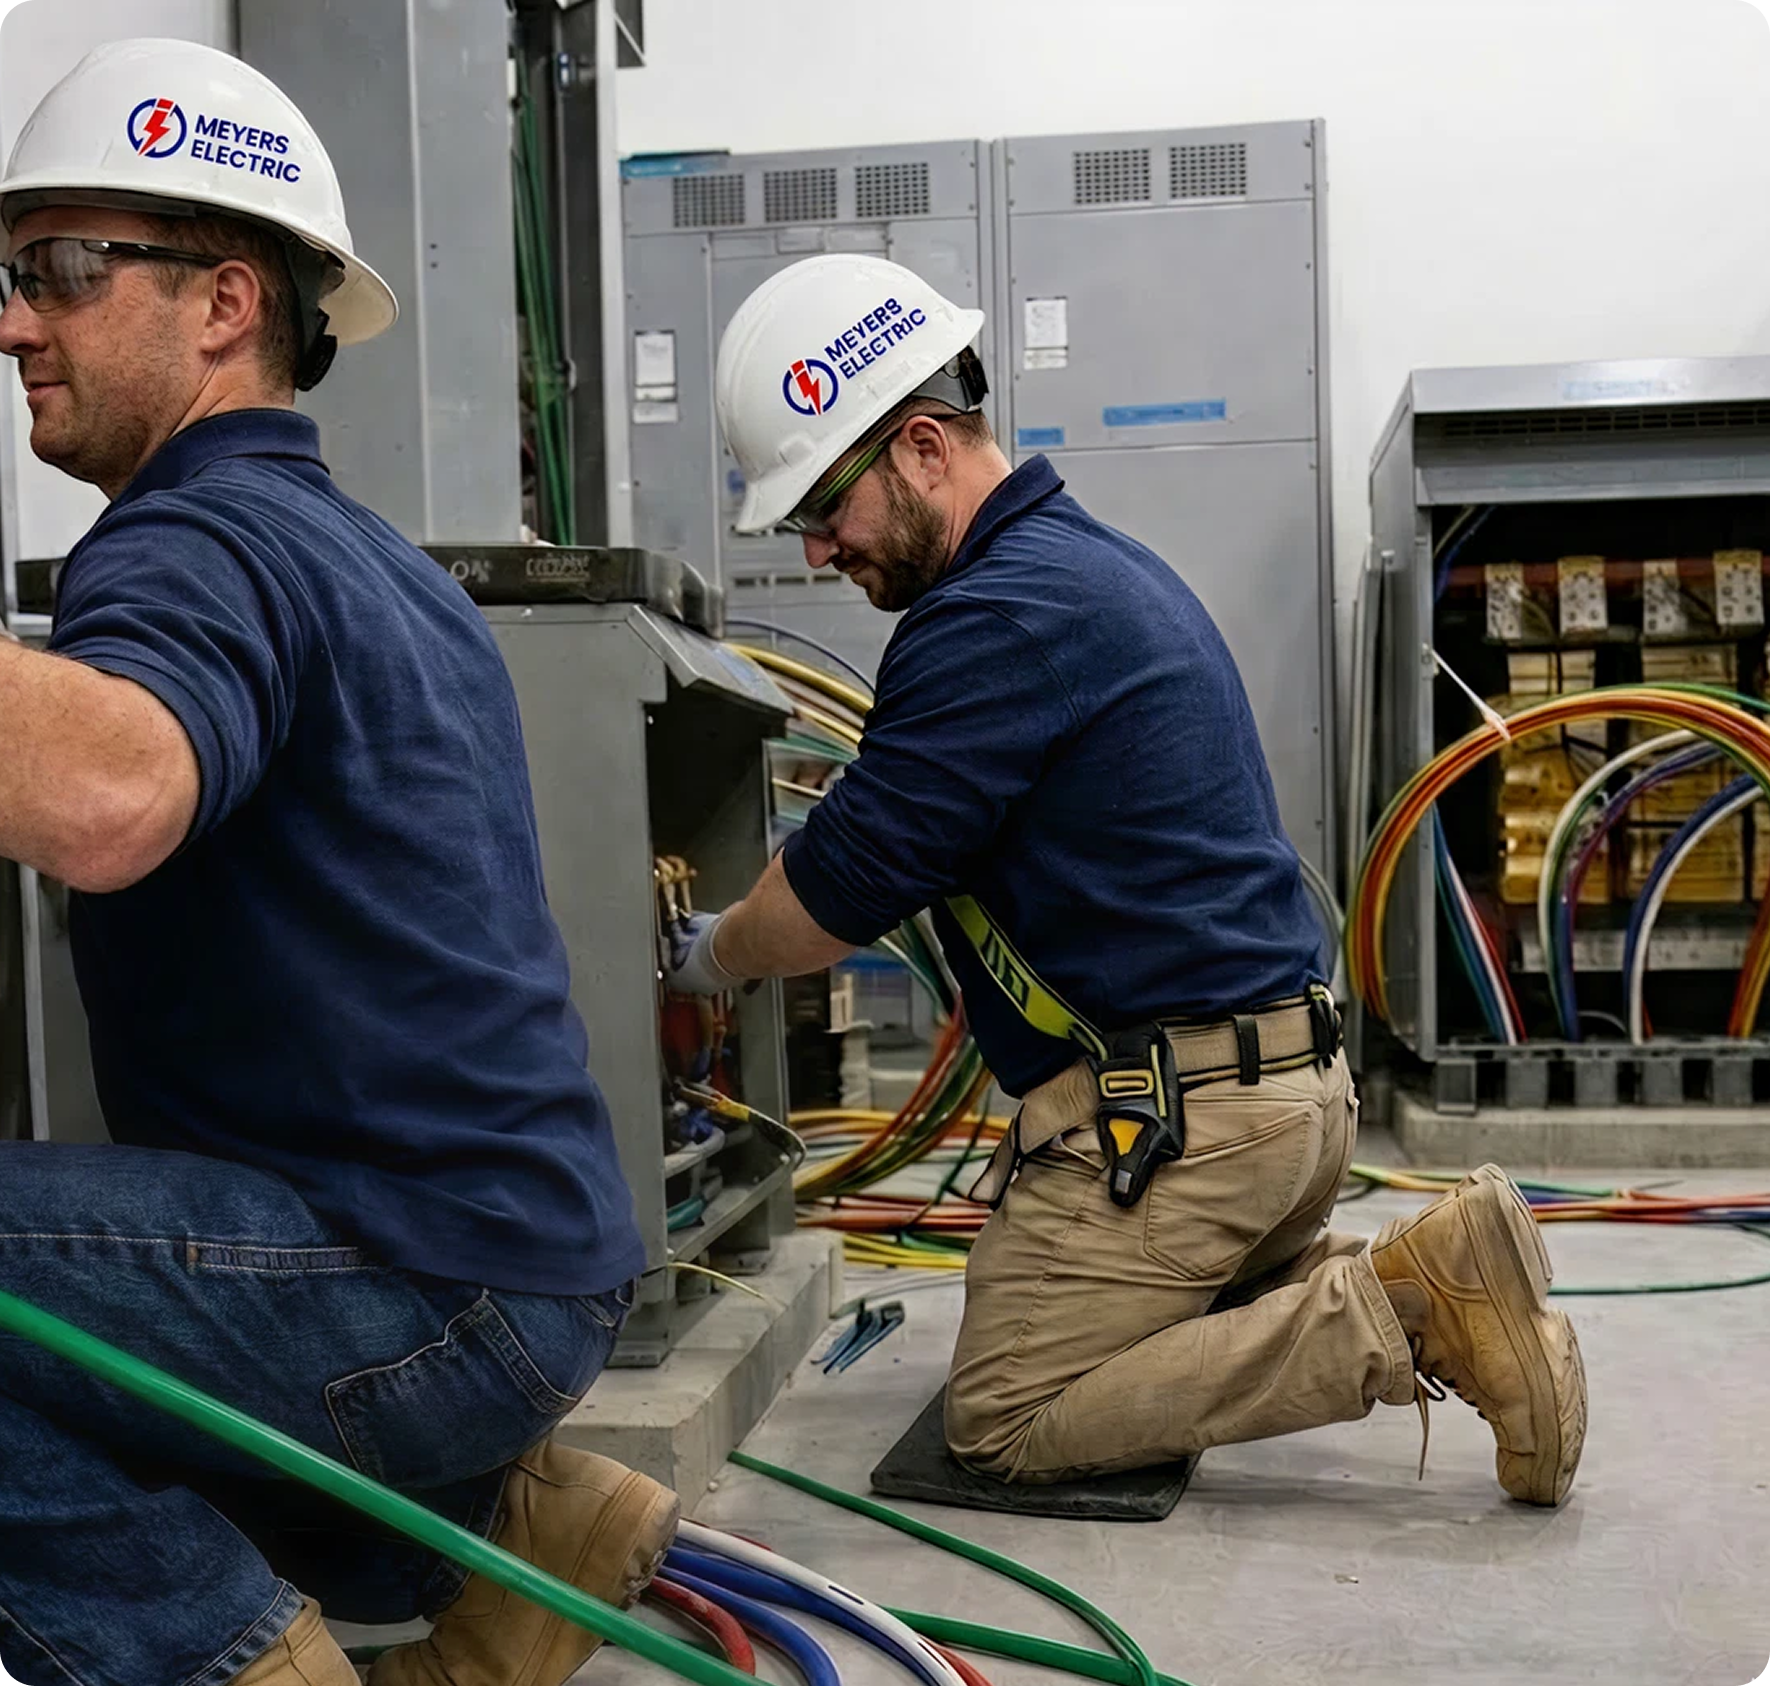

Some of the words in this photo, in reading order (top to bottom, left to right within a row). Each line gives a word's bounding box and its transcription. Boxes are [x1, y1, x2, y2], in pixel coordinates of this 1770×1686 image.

[190, 139, 301, 183] ELECTRIC
[195, 114, 289, 154] MEYERS
[824, 298, 902, 362] MEYERS
[839, 308, 926, 379] ELECTRIC
